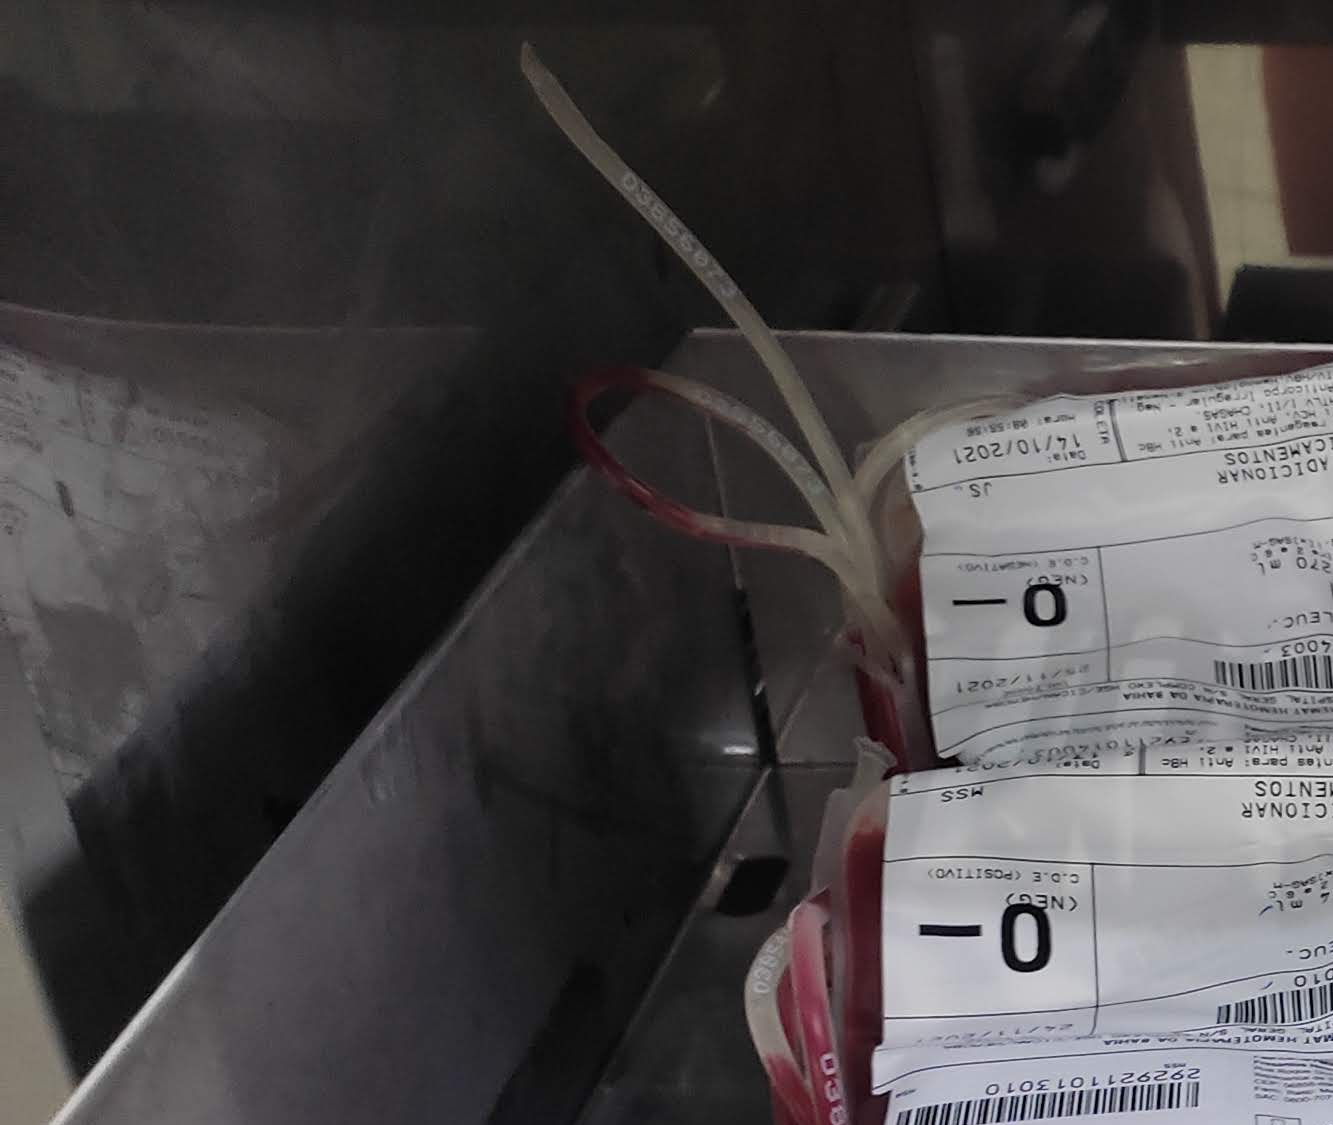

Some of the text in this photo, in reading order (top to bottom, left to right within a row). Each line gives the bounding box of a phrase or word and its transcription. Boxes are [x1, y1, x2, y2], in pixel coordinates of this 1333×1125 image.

[1245, 413, 1278, 427] Anti
[1254, 419, 1327, 439] reagentes
[952, 432, 1081, 466] 14/10/2021
[1169, 437, 1203, 451] Anti
[1215, 456, 1329, 485] ADICIONAR
[1294, 557, 1333, 575] 270
[1122, 690, 1163, 702] BAHIA
[1169, 690, 1188, 701] DA
[1289, 744, 1325, 756] Anti
[1055, 758, 1101, 771] Data:
[1159, 757, 1189, 768] HBc
[1198, 757, 1236, 770] Anti
[1243, 755, 1289, 770] para:
[939, 785, 985, 803] MSS
[1031, 871, 1080, 885] C.D.E
[983, 1065, 1201, 1096] 2929211013010
